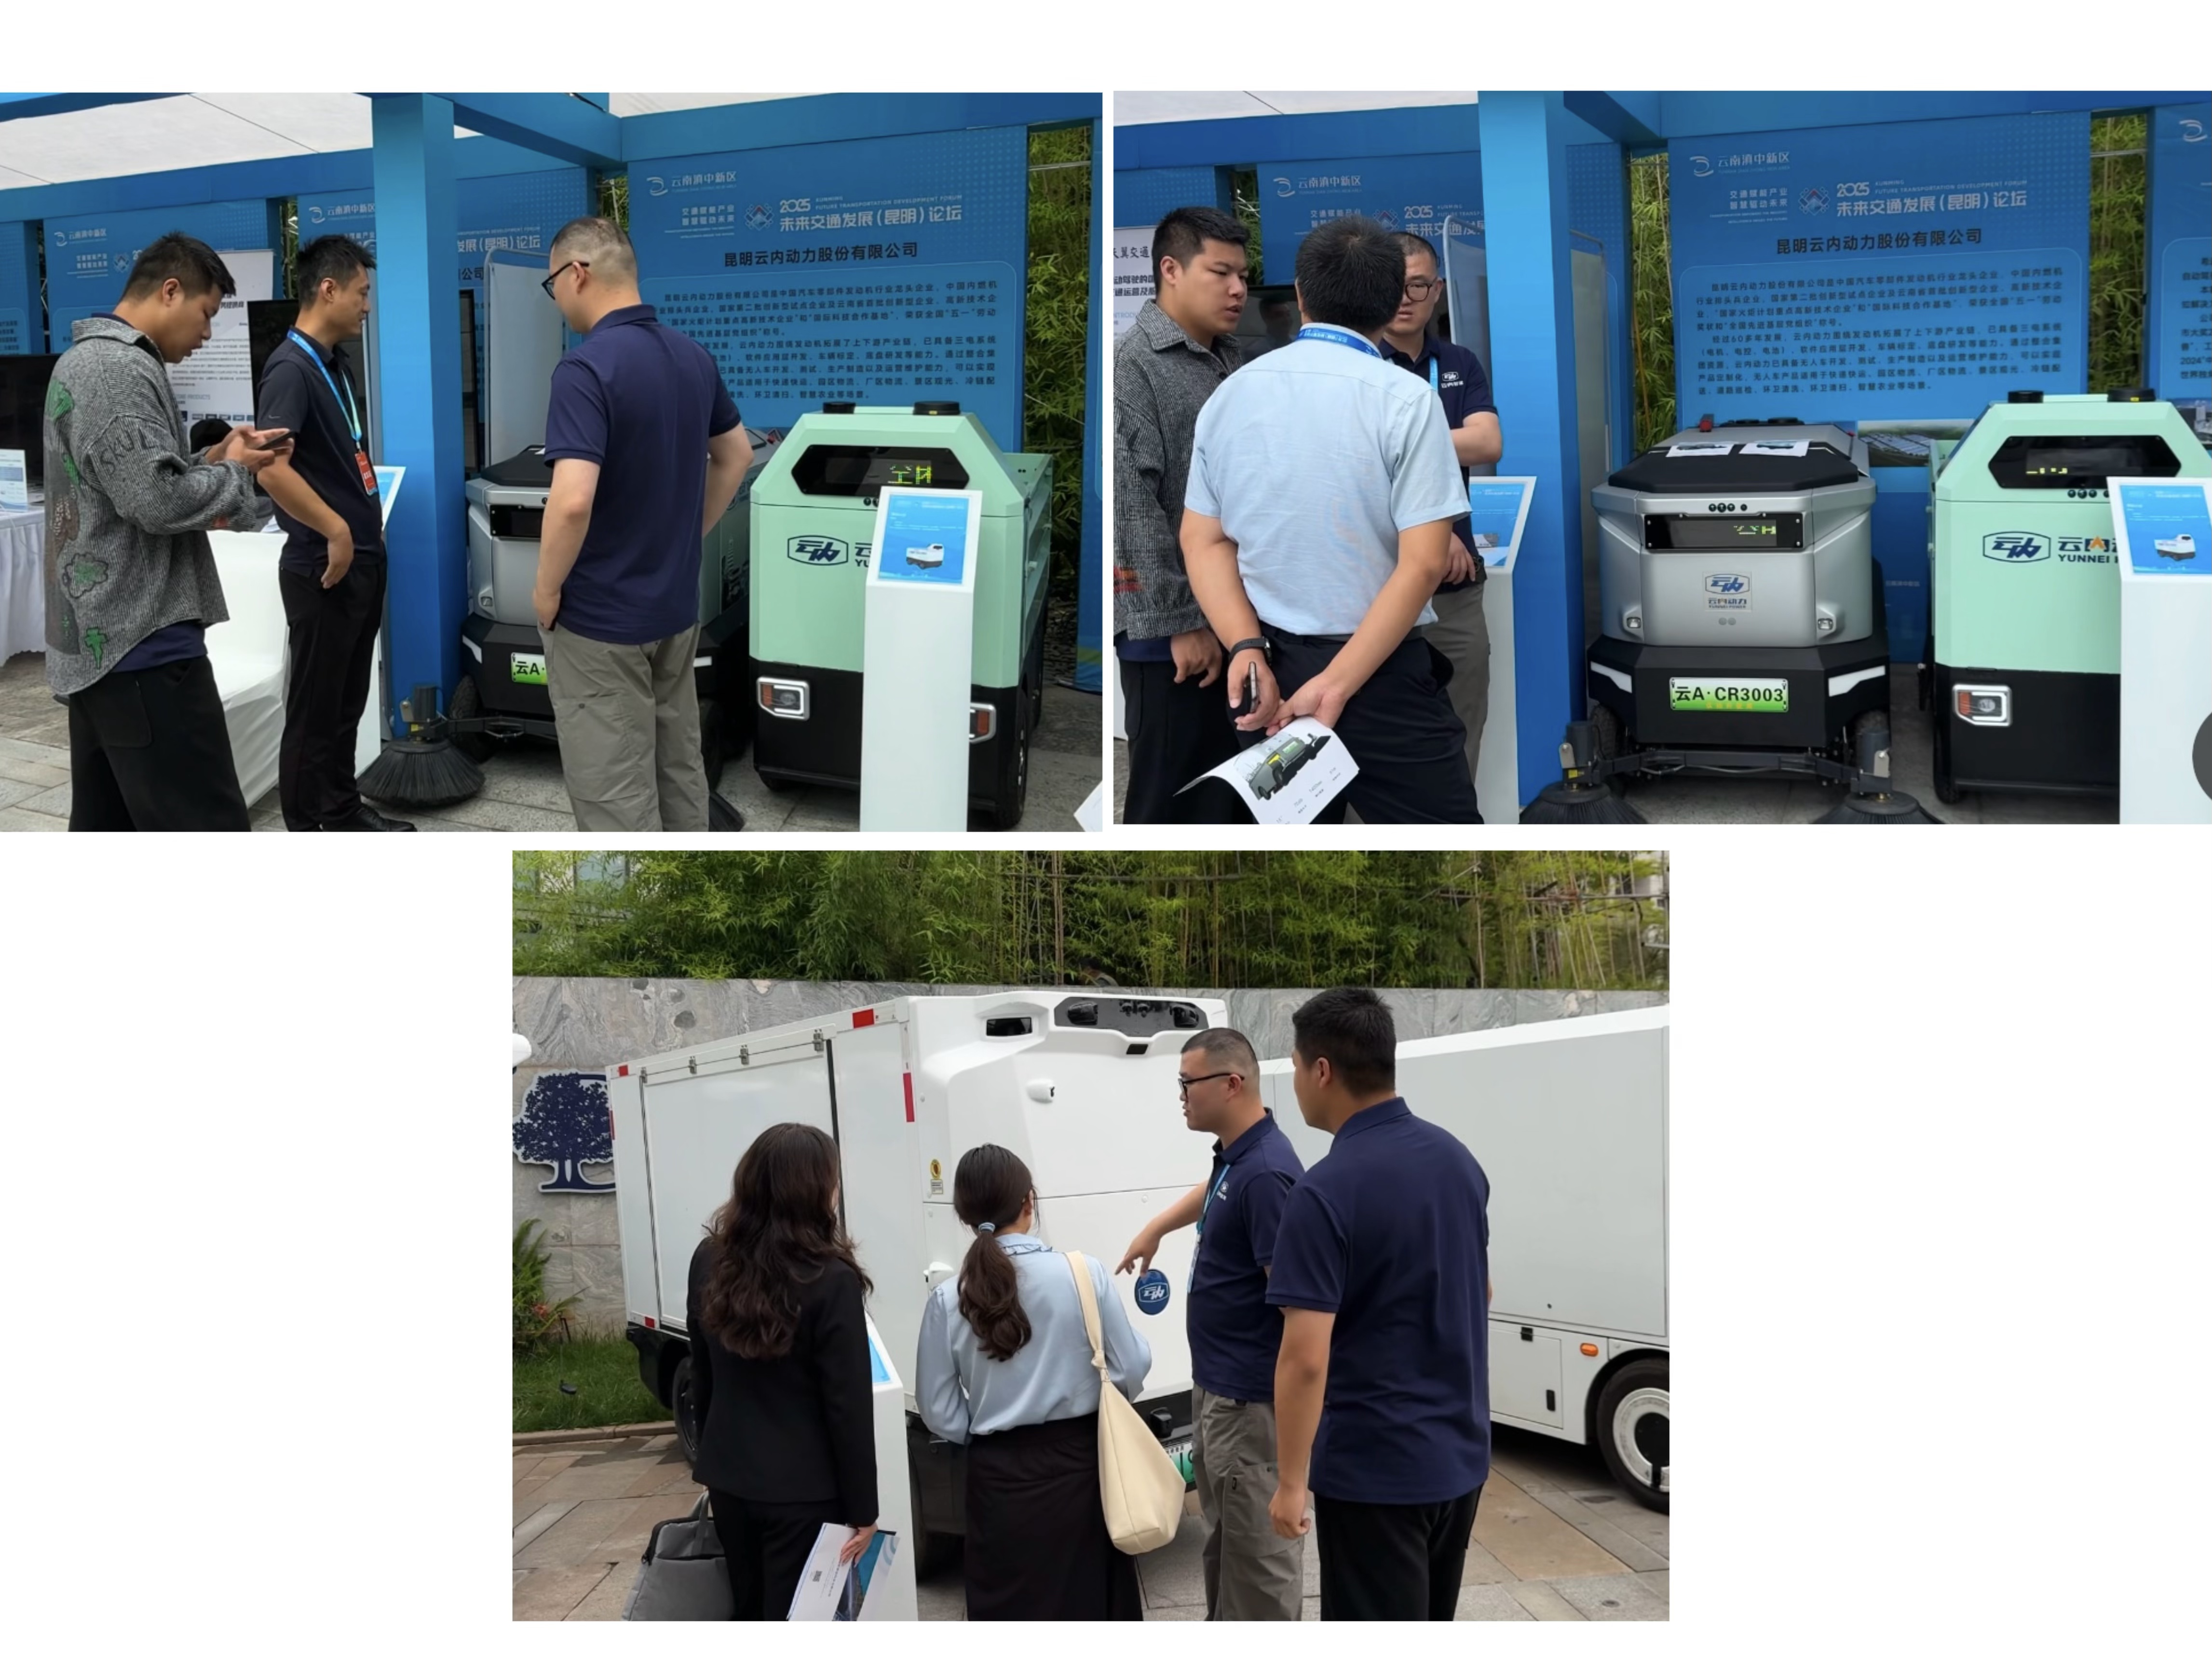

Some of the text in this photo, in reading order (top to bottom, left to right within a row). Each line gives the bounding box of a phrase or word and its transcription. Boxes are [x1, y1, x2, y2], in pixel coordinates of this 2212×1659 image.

[1718, 151, 1790, 167] 云南滇中新区
[672, 171, 736, 187] 云南滇中新区
[1298, 175, 1362, 189] 云南滇中新区
[1836, 182, 1870, 198] 2025
[779, 198, 811, 213] 2025
[1836, 190, 2027, 217] 未来交通发展（昆明）论坛
[779, 205, 962, 232] 未来交通发展（昆明）论坛
[1404, 205, 1433, 219] 2025
[1777, 228, 1982, 254] 昆明云内动力股份有限公司
[724, 242, 918, 267] 昆明云内动力股份有限公司
[458, 267, 484, 281] 公司
[2058, 536, 2117, 552] 云内
[2058, 554, 2110, 564] YUNNEI
[1675, 686, 1783, 702] 云A·CR3003
